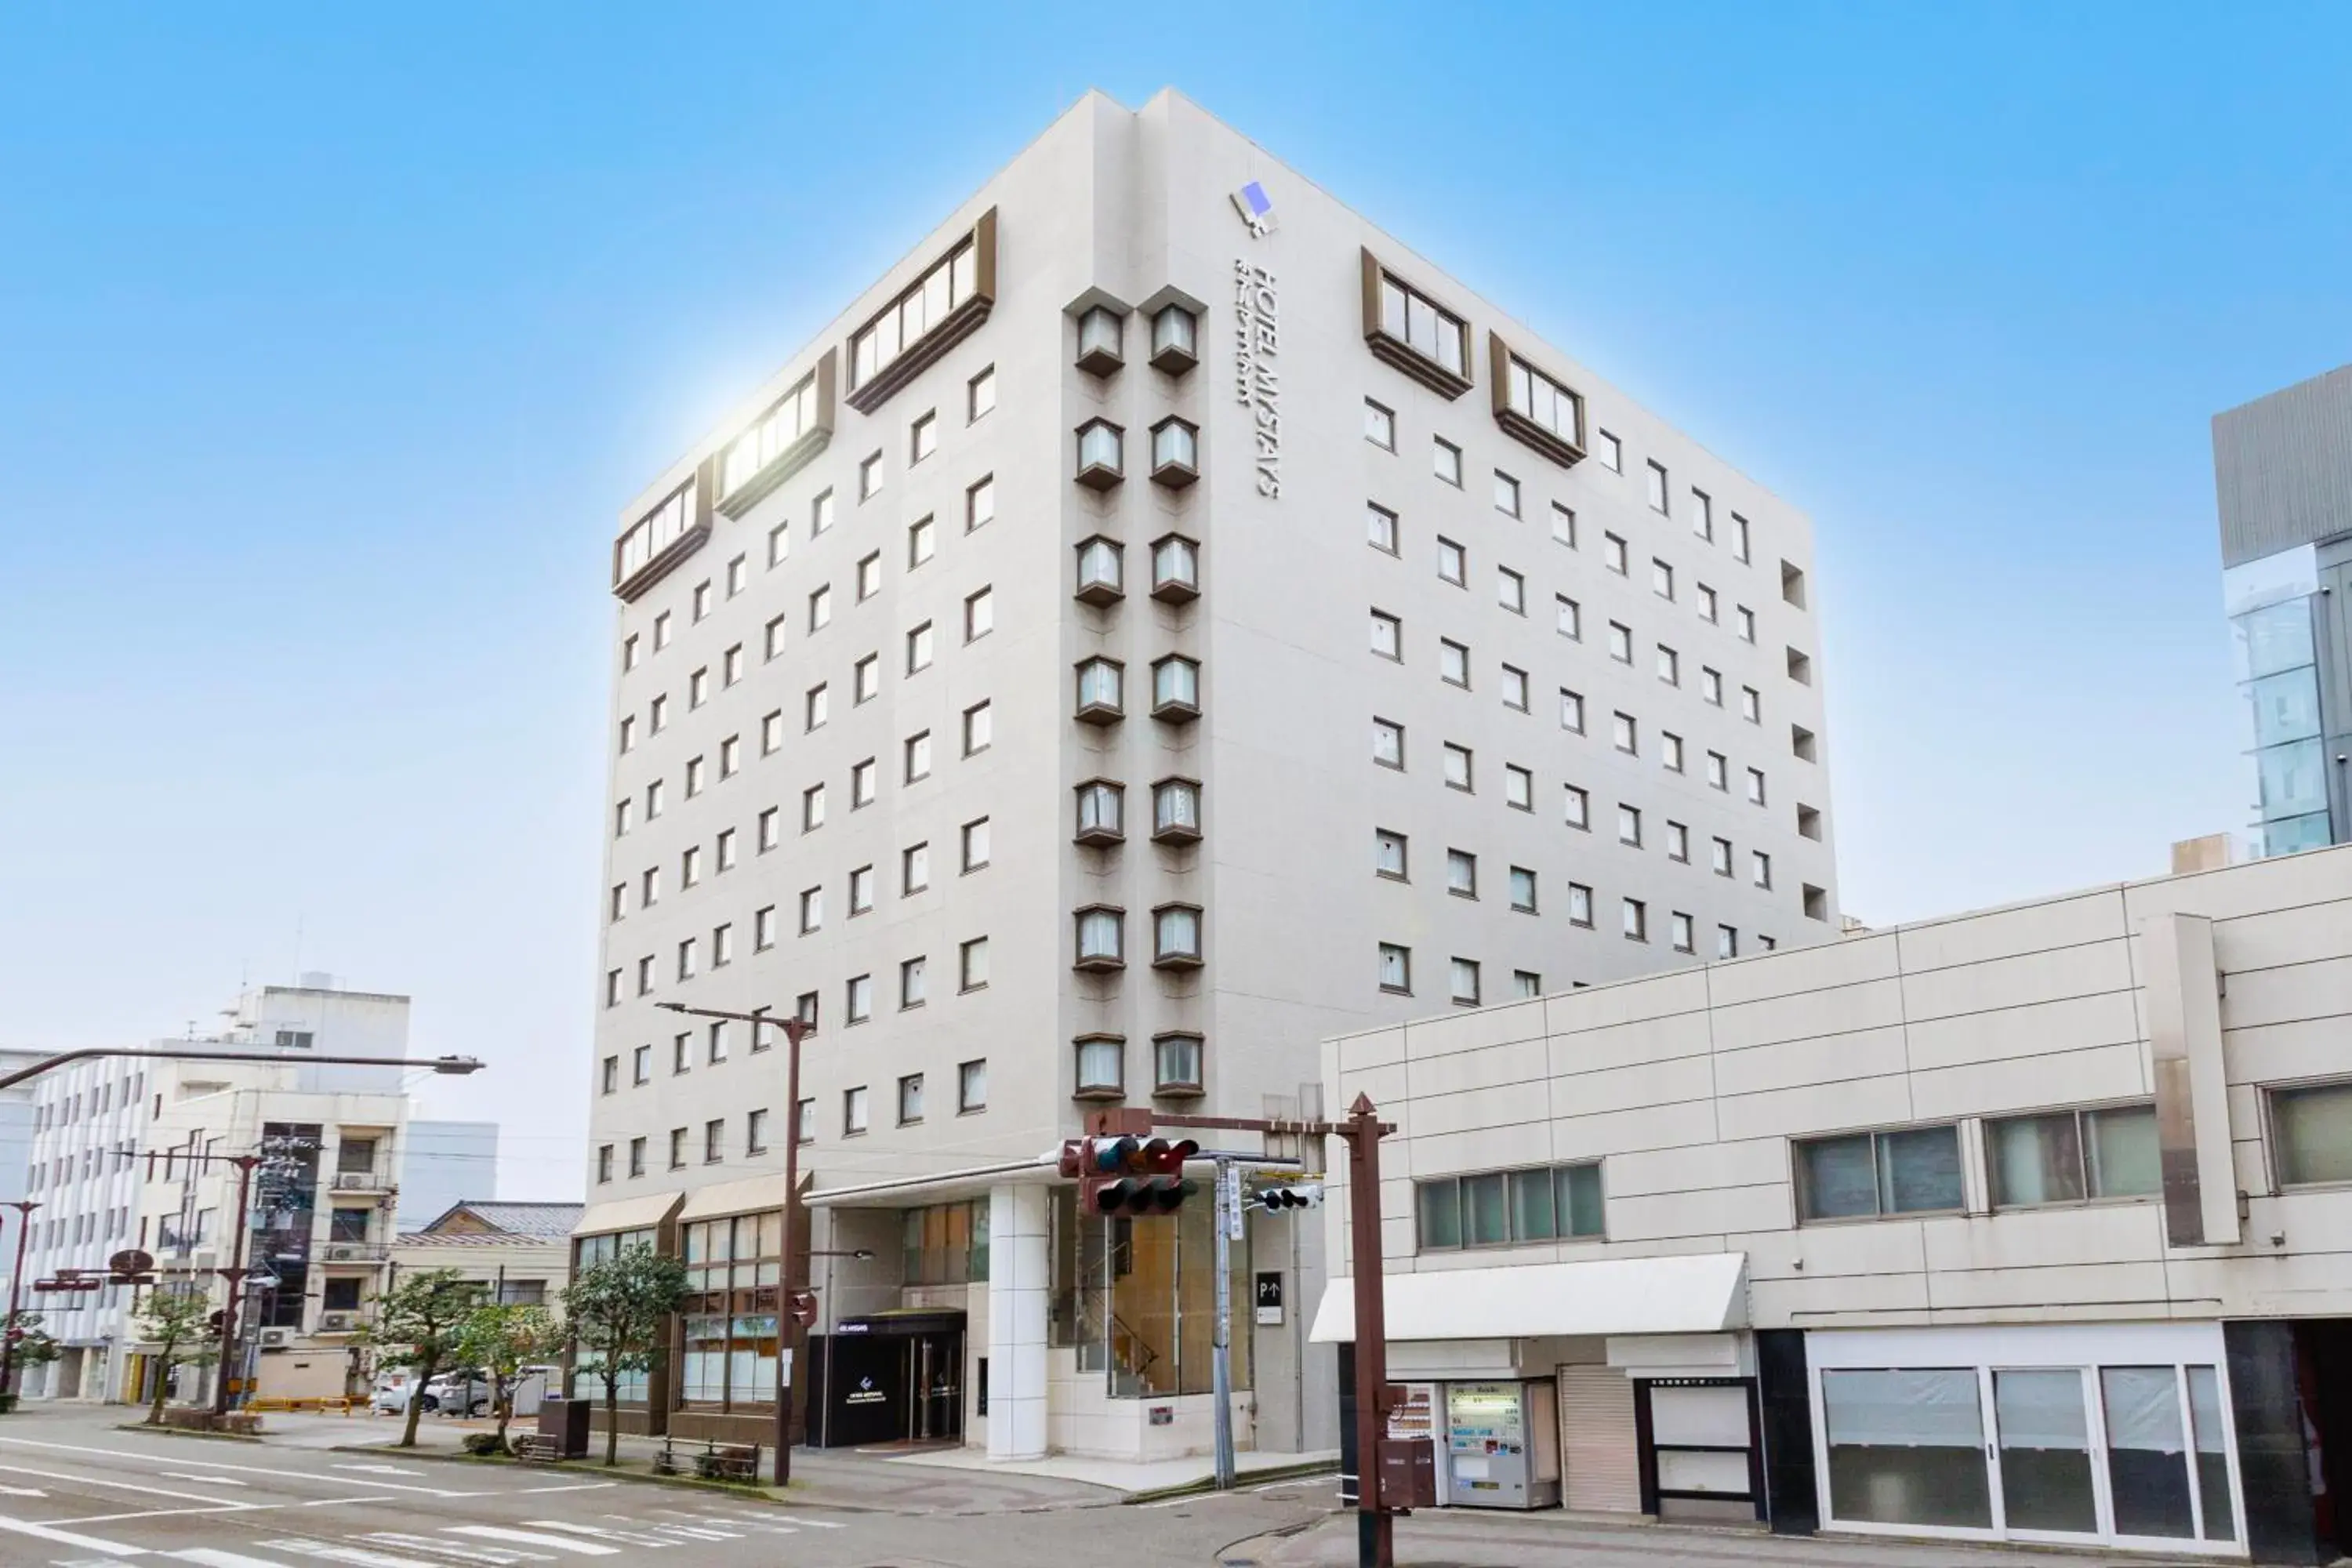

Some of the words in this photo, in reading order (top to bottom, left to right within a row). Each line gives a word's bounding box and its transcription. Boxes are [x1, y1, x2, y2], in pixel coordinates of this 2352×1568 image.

[1254, 265, 1277, 357] HOTEL
[1255, 364, 1279, 500] MYSTAYS
[1260, 1282, 1268, 1298] P
